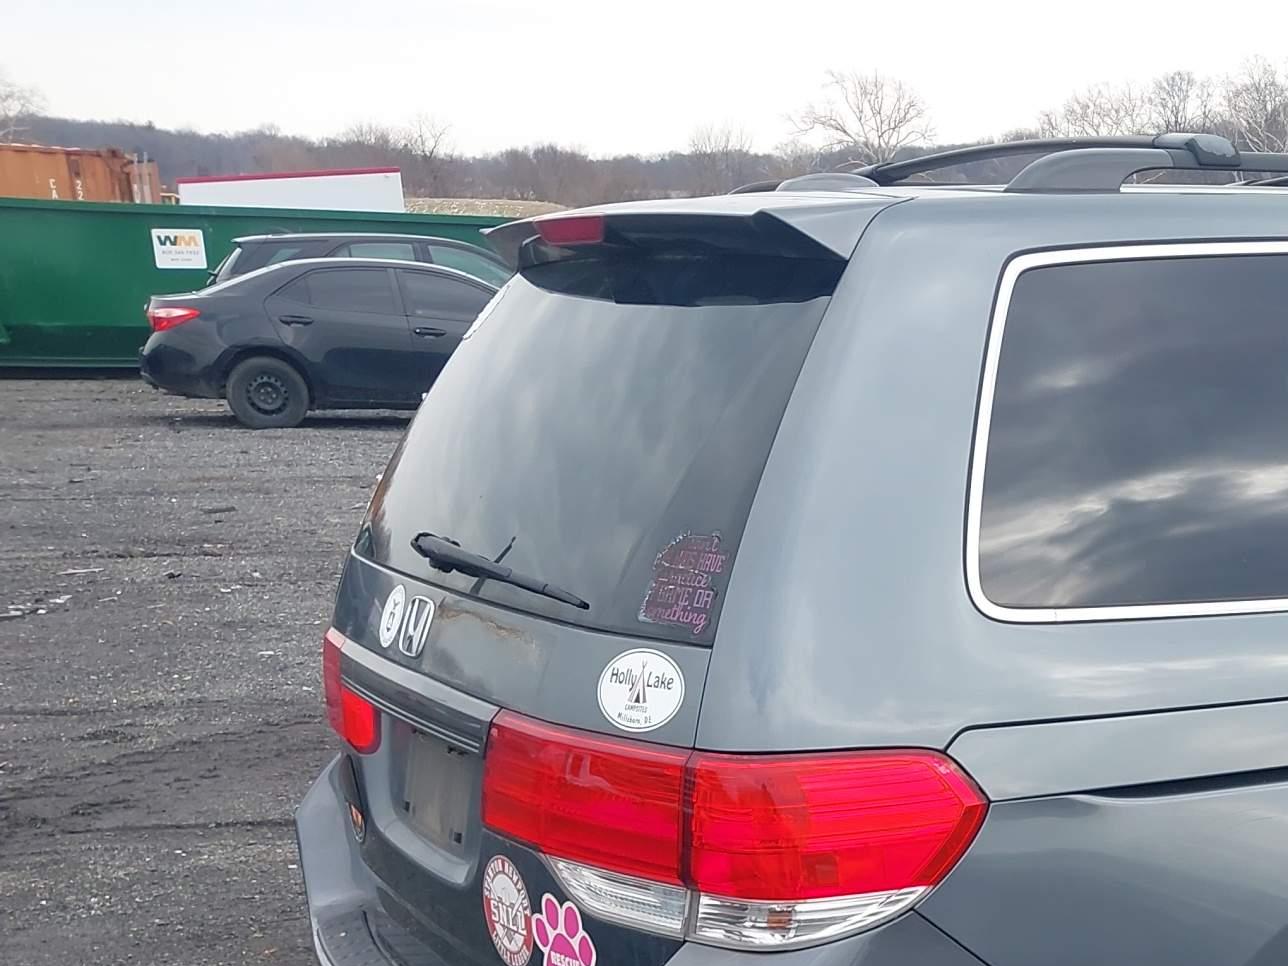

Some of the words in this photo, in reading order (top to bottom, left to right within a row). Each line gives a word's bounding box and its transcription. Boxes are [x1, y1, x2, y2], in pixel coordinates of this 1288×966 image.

[156, 235, 200, 247] WM
[609, 667, 638, 692] Holly
[646, 671, 674, 690] Lake
